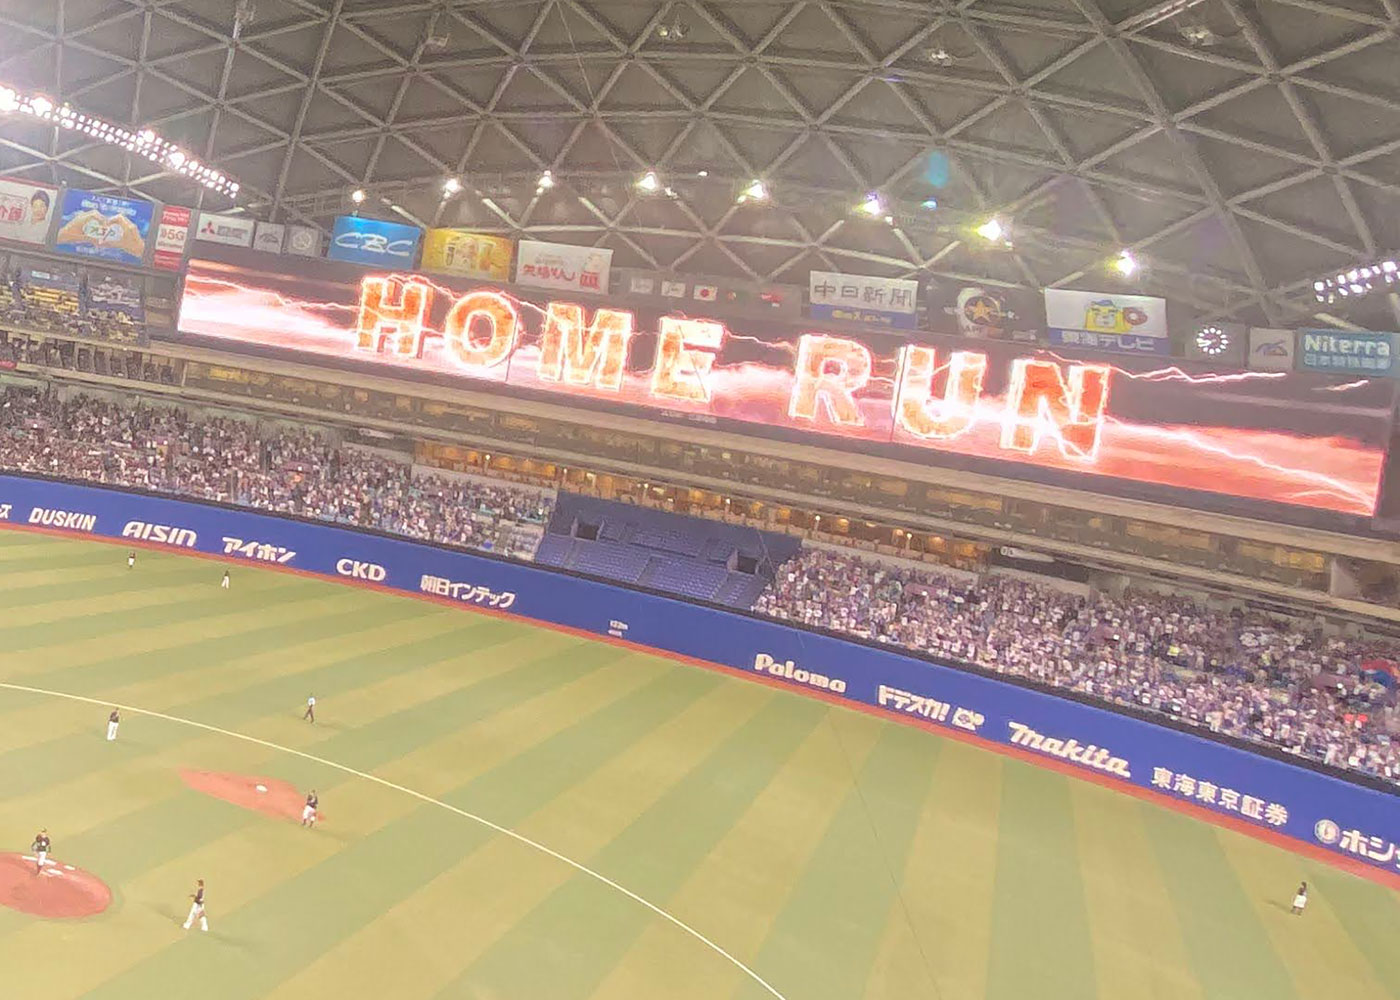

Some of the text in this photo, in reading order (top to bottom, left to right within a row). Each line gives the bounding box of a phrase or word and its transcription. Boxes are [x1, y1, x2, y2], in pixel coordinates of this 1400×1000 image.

[335, 232, 412, 256] CBC
[814, 280, 913, 307] 中日新聞
[1304, 334, 1390, 357] Niterra
[354, 274, 1111, 464] HOME RUN
[28, 507, 97, 532] DUSKIN
[122, 520, 198, 547] AISIN
[222, 536, 297, 563] アイホン
[336, 558, 387, 582] CKD
[420, 574, 516, 609] 朝日インテック
[754, 653, 847, 693] Paloma
[1151, 766, 1289, 827] 東海東京証券
[1339, 829, 1400, 869] ホシ
